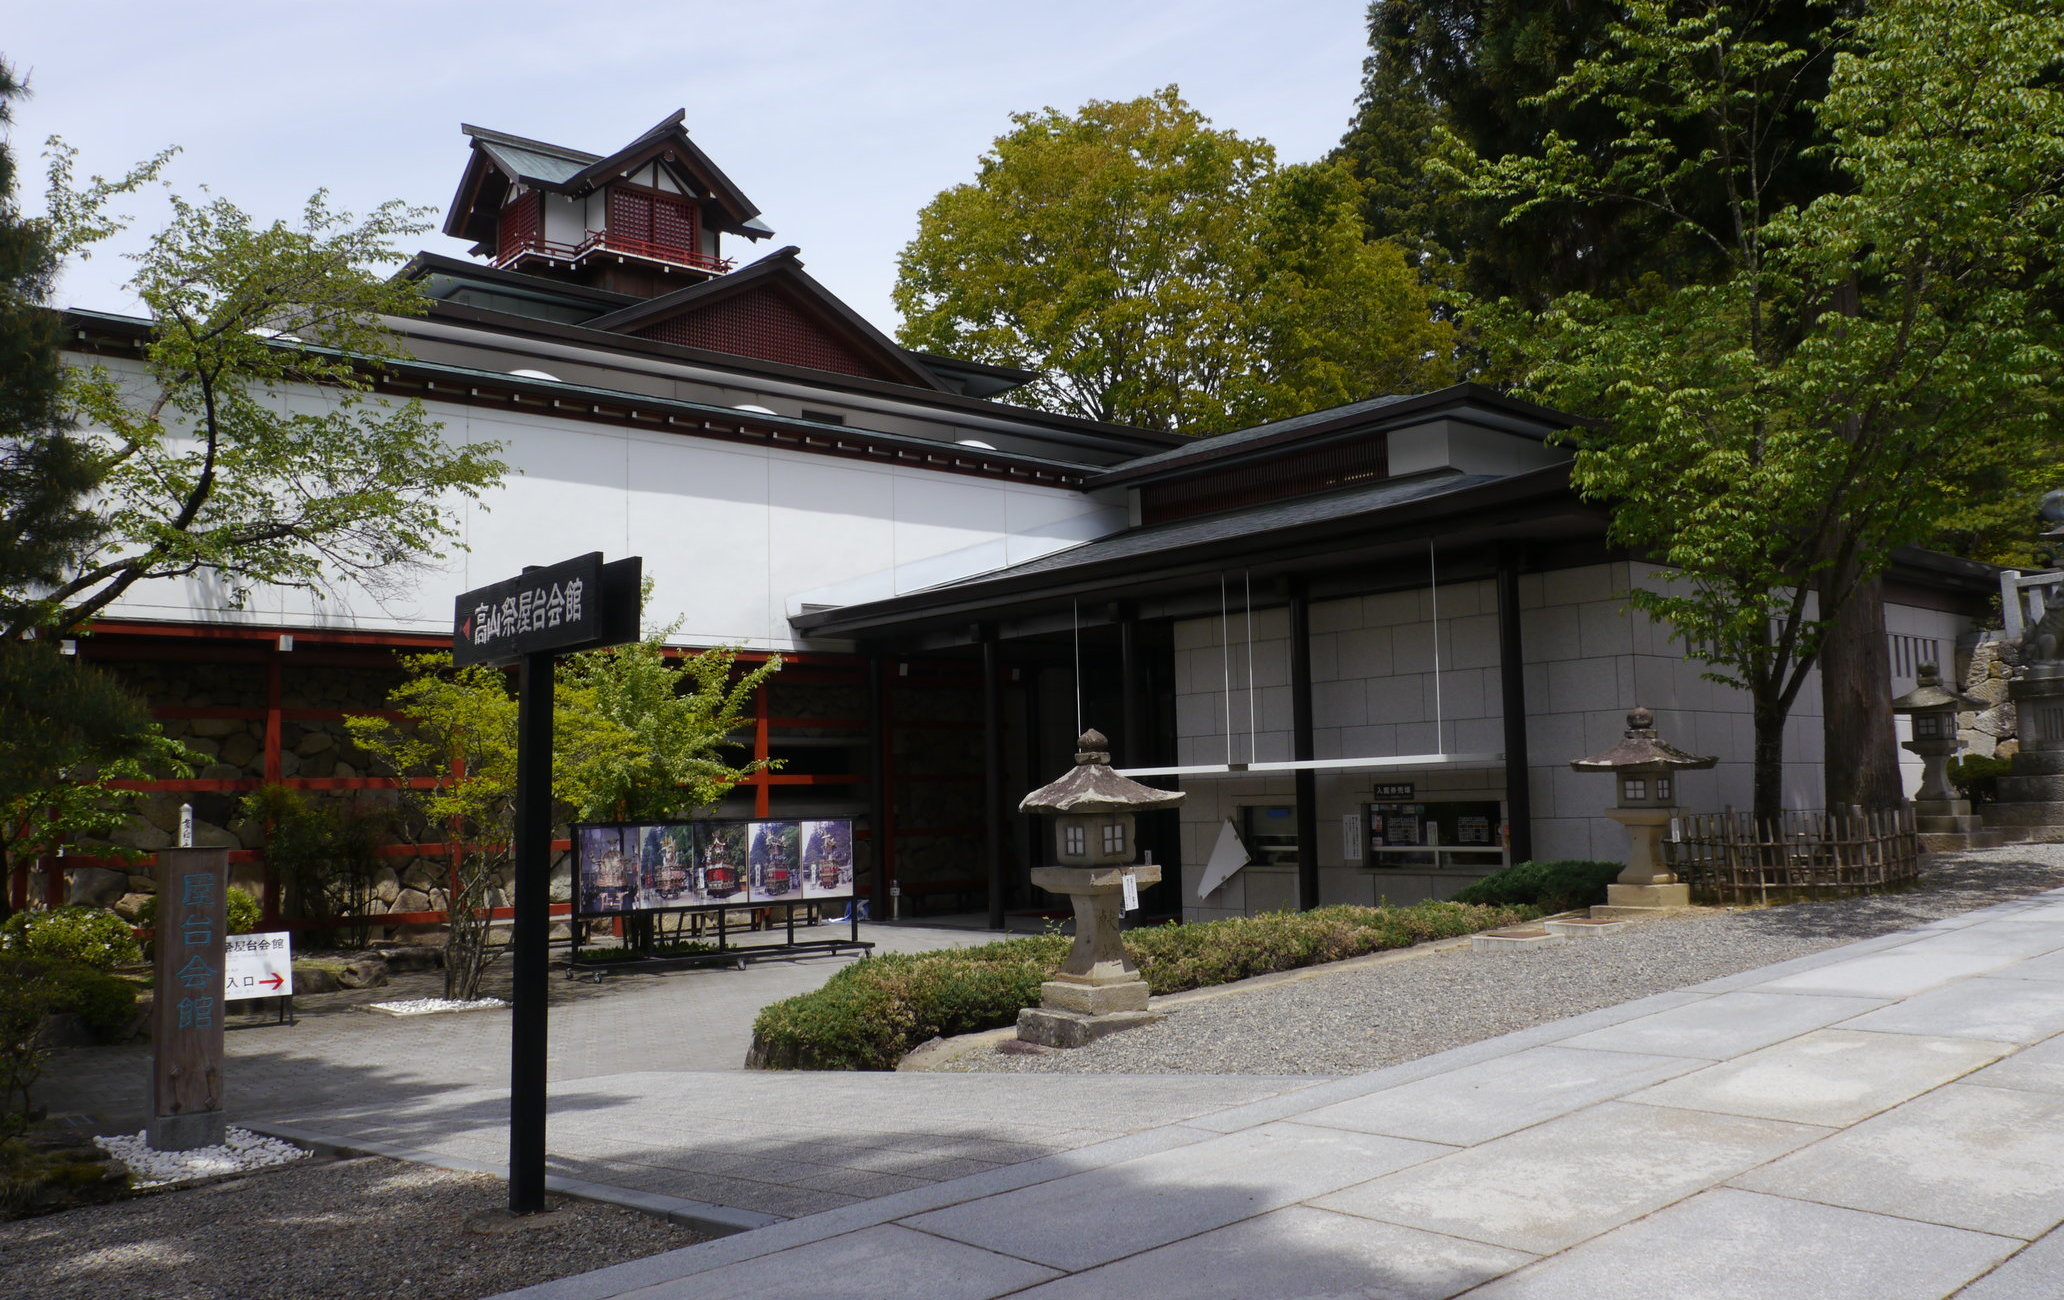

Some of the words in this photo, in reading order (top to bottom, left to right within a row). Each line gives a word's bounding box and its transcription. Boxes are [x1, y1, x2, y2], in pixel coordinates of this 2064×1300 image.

[474, 577, 583, 645] 高山祭屋台会館
[176, 872, 218, 1031] 屋台会館
[226, 976, 254, 989] 入口
